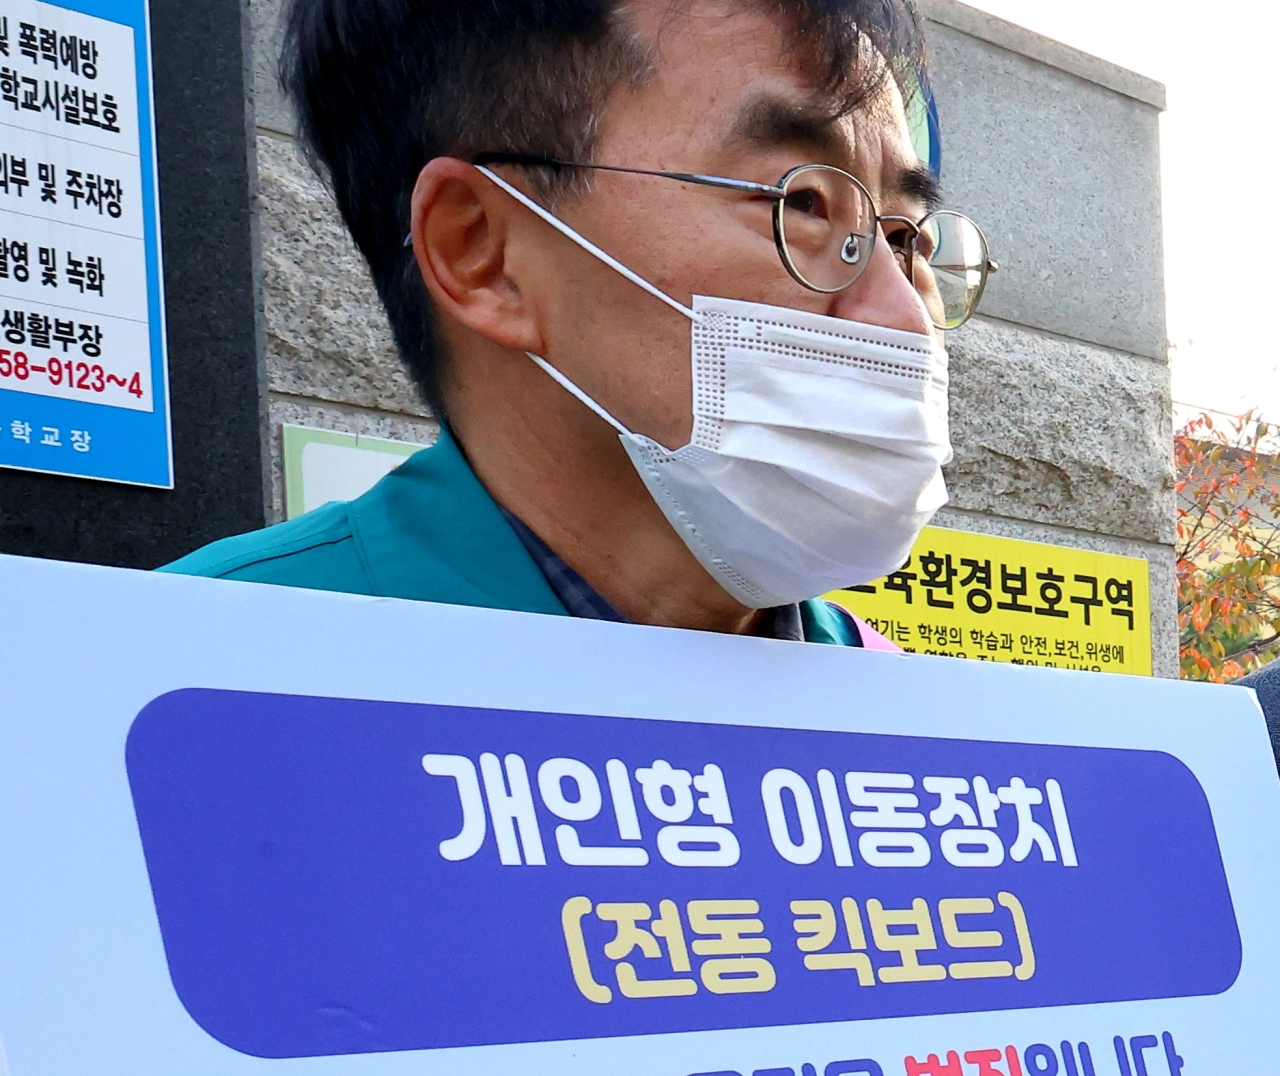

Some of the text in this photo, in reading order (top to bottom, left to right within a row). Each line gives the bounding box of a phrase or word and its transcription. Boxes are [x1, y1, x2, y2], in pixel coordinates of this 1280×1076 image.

[19, 21, 99, 80] 폭력예방
[0, 66, 121, 133] 학교시설보호
[38, 163, 57, 204] 및
[65, 169, 123, 219] 주차장
[38, 246, 58, 288] 및
[65, 251, 105, 297] 녹화
[1, 309, 103, 357] 생활부장
[840, 550, 1134, 631] 육환경보호구역
[917, 622, 963, 647] 학생의
[969, 627, 1015, 653] 학습과
[421, 751, 1080, 869] 개인형 이동장치
[561, 890, 1038, 1005] (전동 킥보드)
